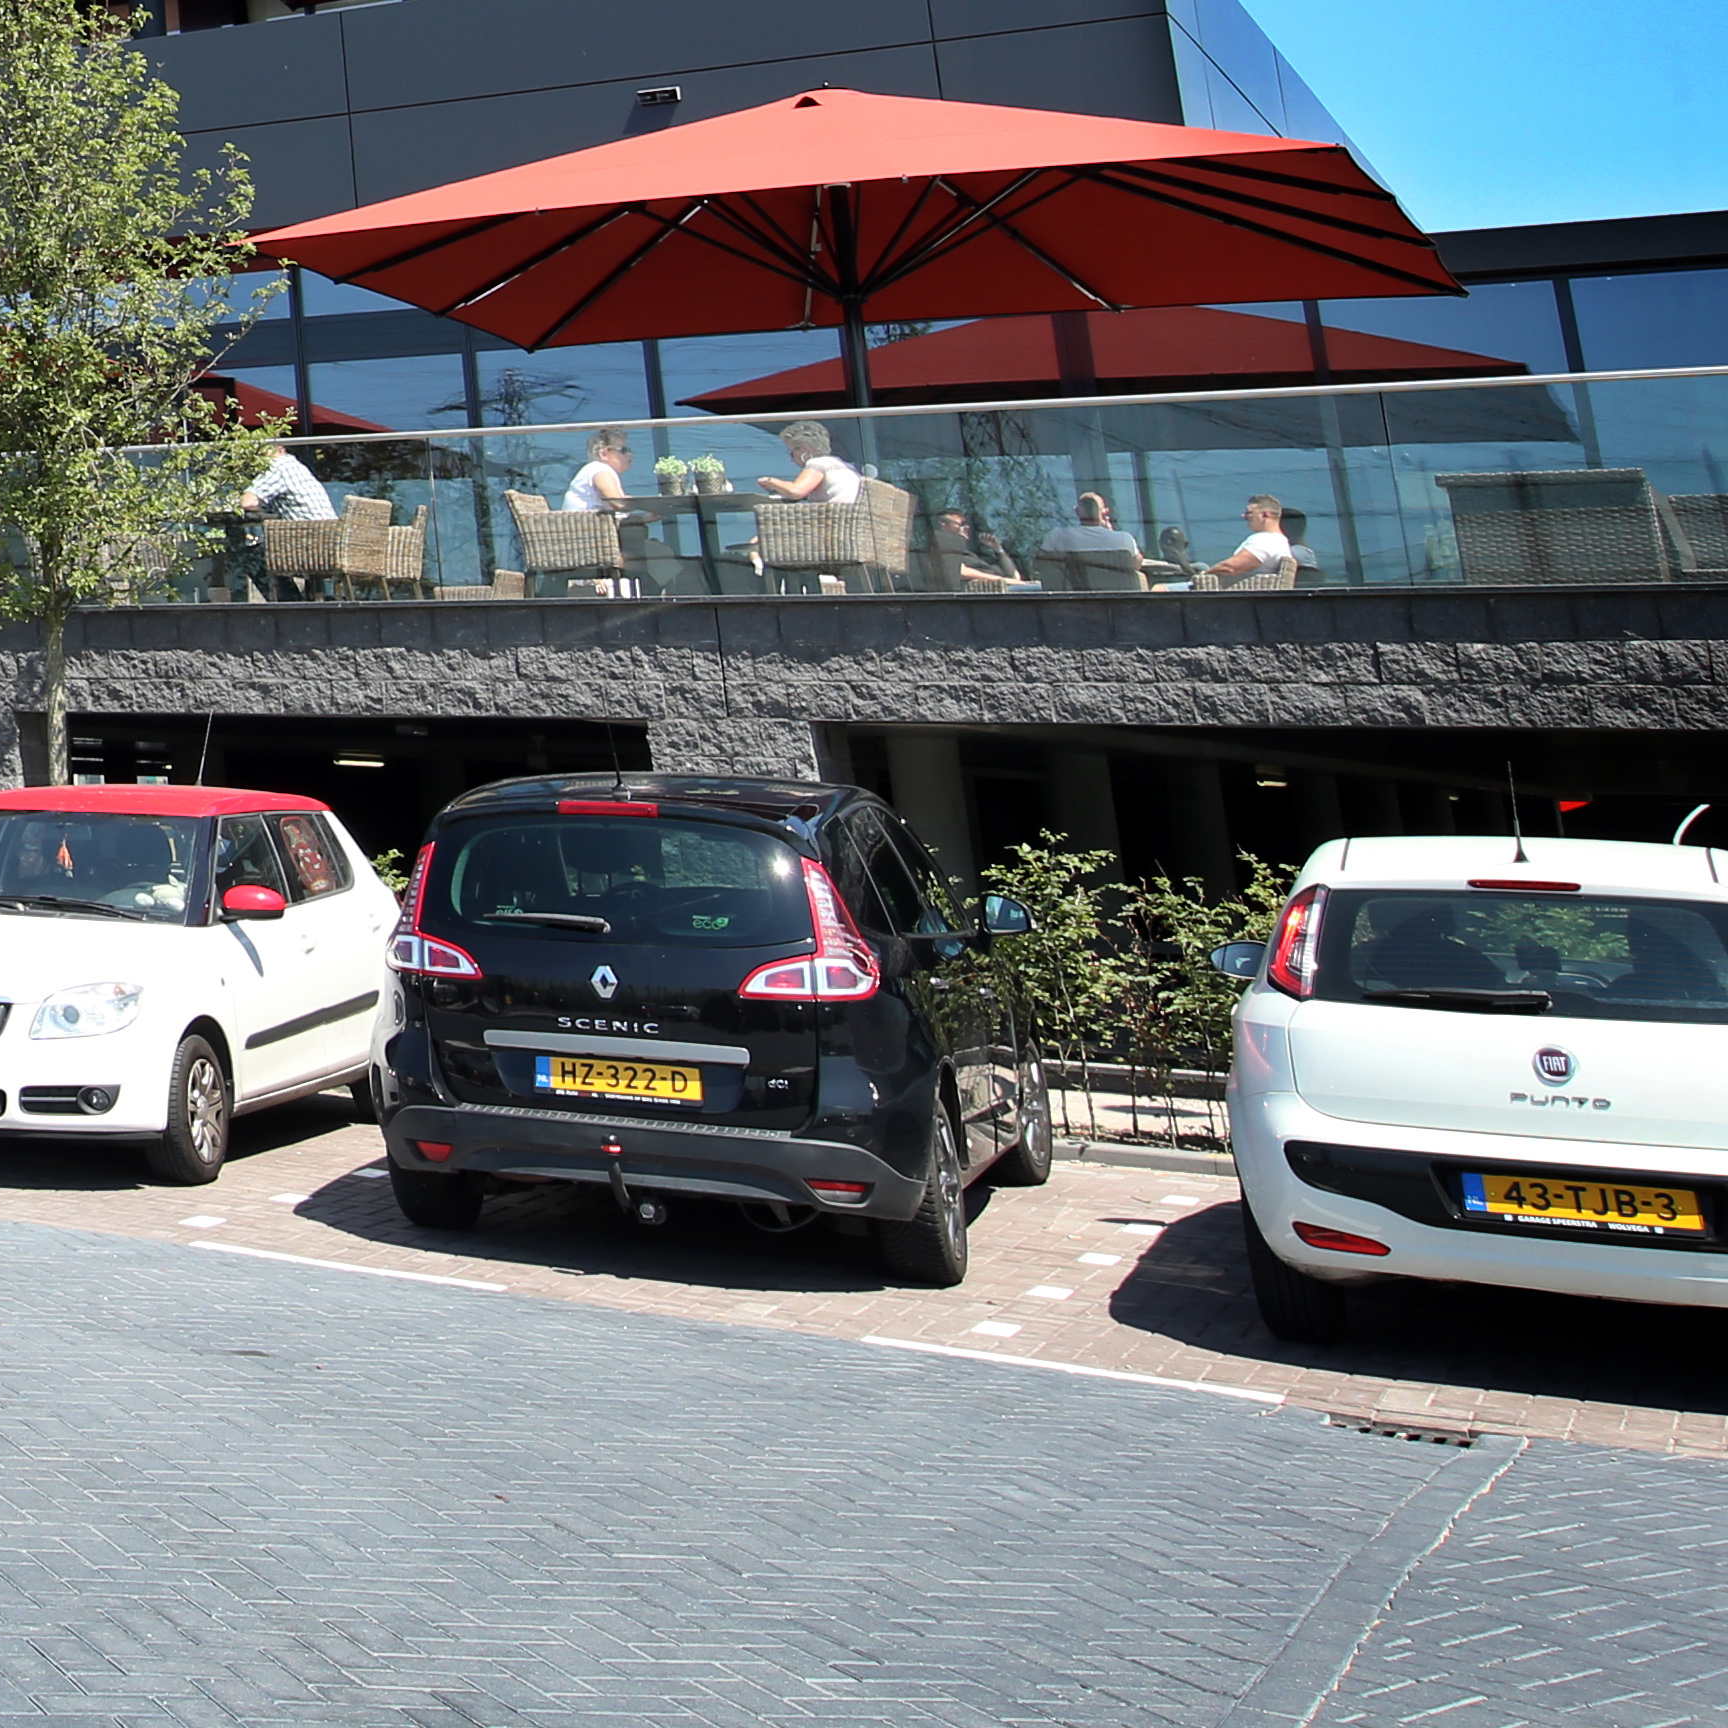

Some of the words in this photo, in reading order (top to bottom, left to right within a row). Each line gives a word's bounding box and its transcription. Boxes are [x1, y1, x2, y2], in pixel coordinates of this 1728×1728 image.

[557, 1016, 660, 1034] SCENIC
[1542, 1055, 1566, 1072] FIAT
[560, 1060, 688, 1094] HZ-322-D
[1509, 1092, 1612, 1111] PUNTO
[1503, 1180, 1678, 1222] 43-TJB-3
